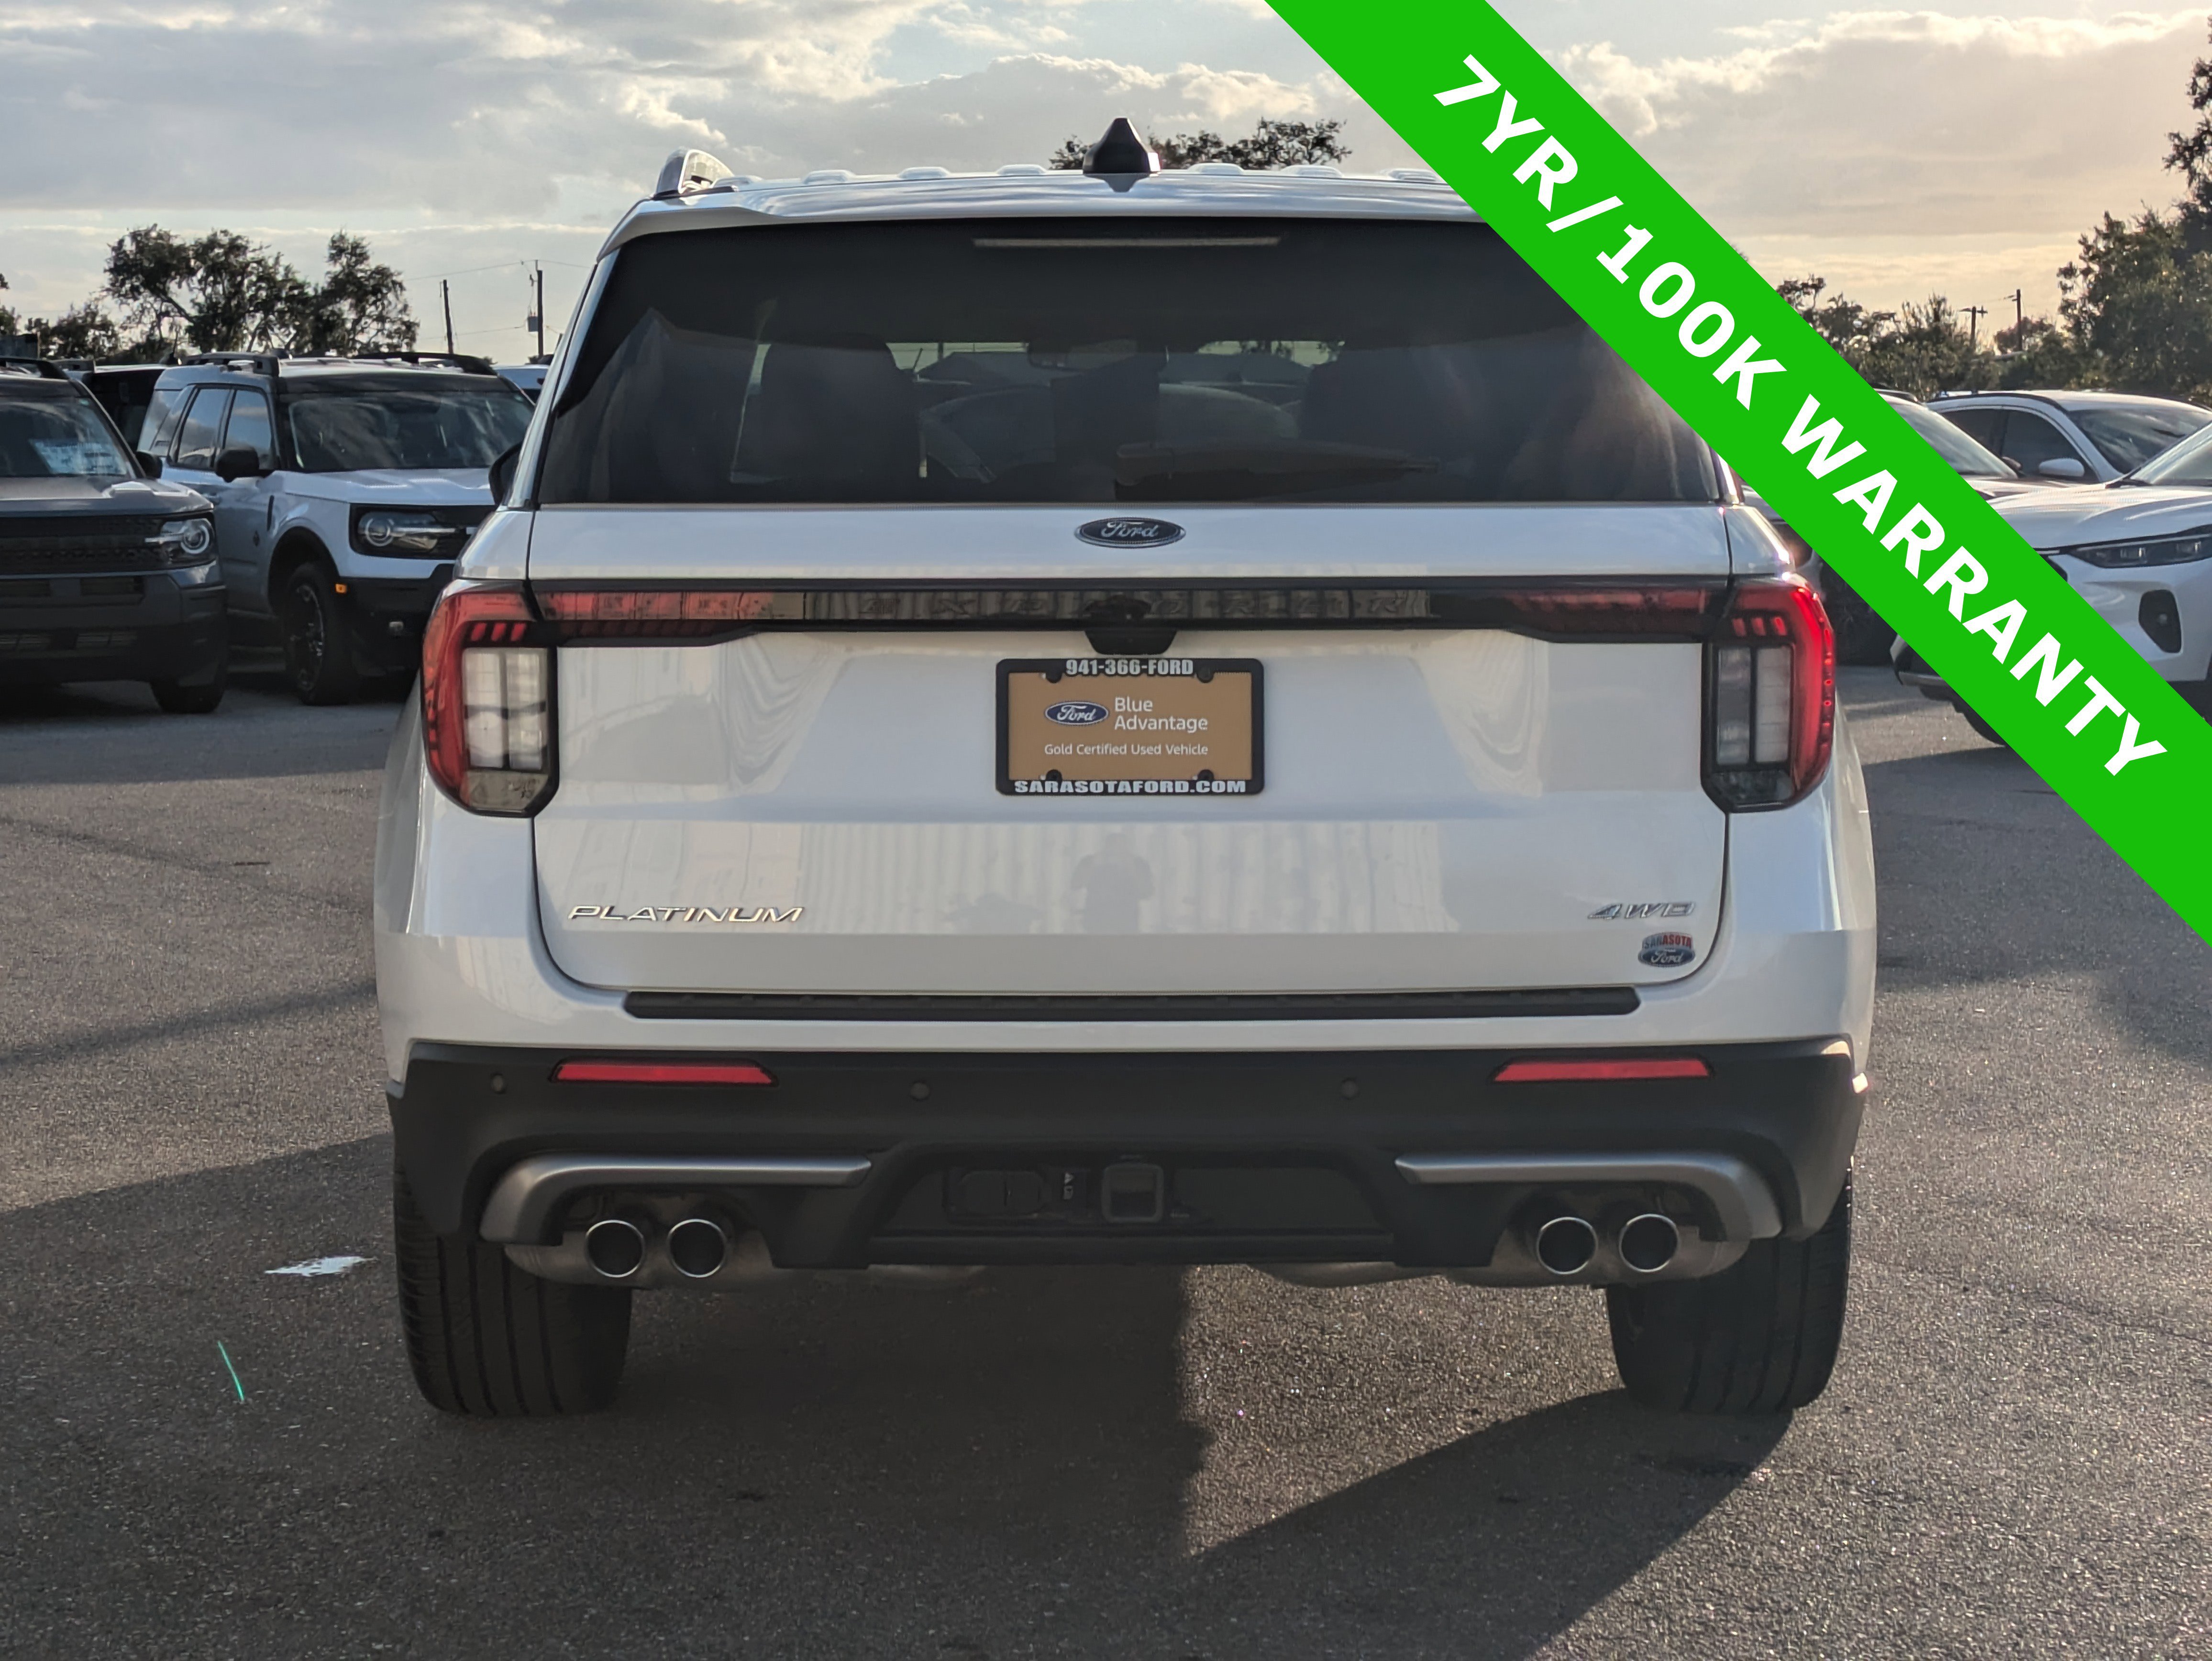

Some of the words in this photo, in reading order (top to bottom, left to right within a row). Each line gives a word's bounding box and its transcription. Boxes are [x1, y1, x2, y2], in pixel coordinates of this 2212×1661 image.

[1101, 521, 1159, 537] Ford
[1066, 659, 1194, 675] 941-366-FORD
[1115, 697, 1153, 712] Blue
[1057, 705, 1096, 721] Ford
[1114, 715, 1208, 733] Advantage
[1044, 744, 1073, 755] Gold
[1077, 743, 1127, 755] Certified
[1131, 744, 1161, 755] Used
[1166, 744, 1208, 755] Vehicle
[1014, 780, 1246, 793] SARASOTAFORD.COM
[568, 905, 805, 923] PLATINUM
[1587, 902, 1695, 919] 4WD
[1644, 933, 1692, 950] SARASOTA
[1650, 948, 1684, 963] Ford
